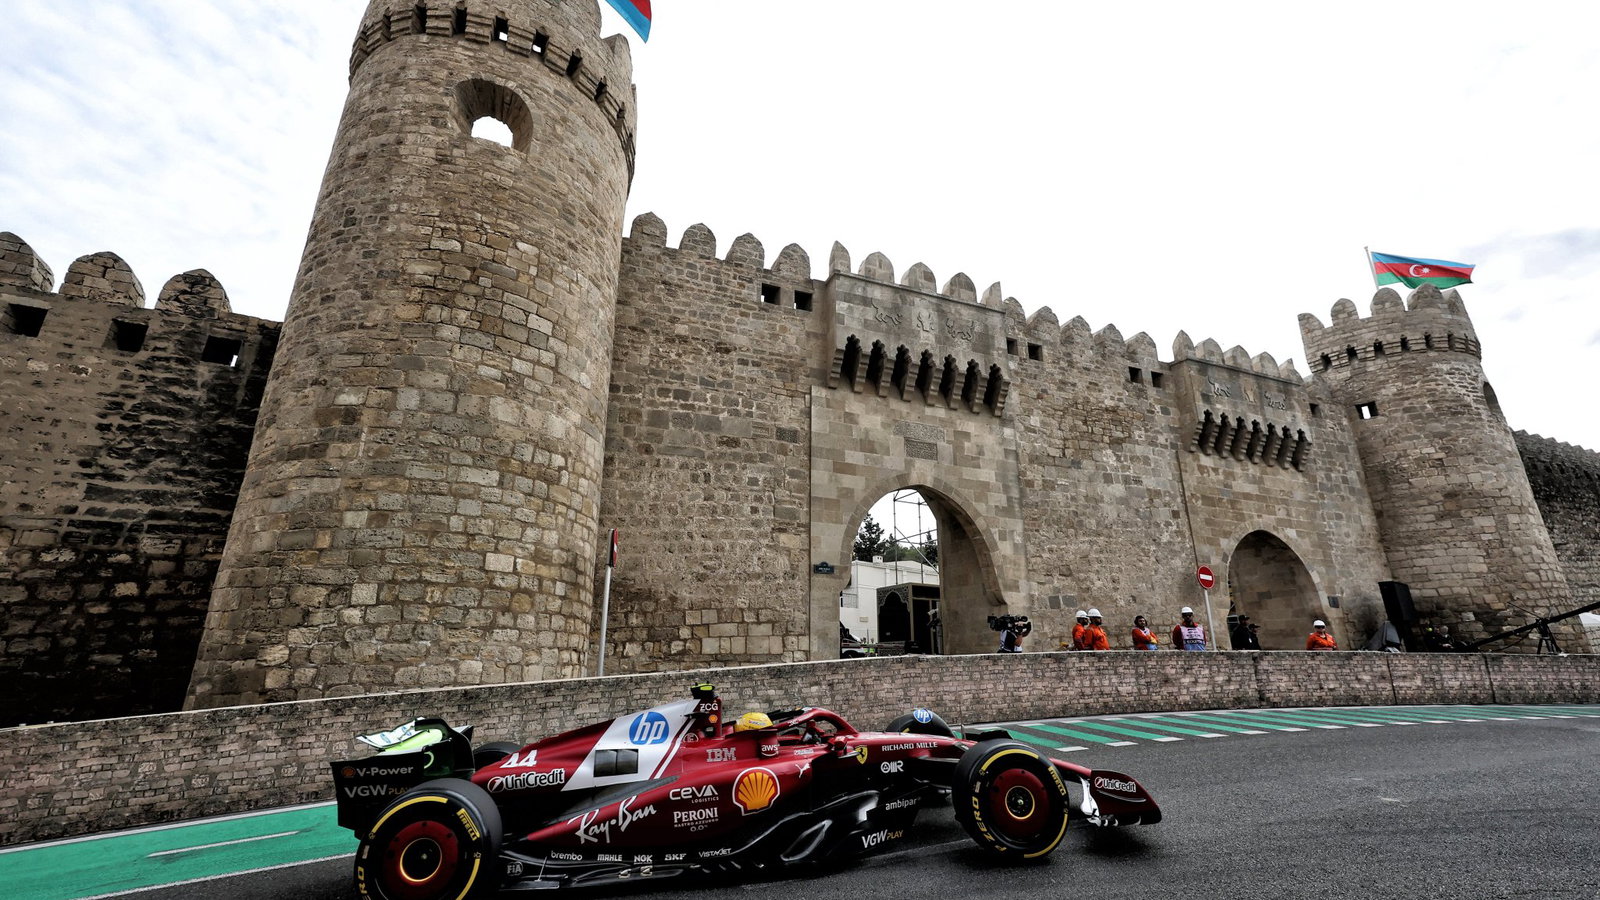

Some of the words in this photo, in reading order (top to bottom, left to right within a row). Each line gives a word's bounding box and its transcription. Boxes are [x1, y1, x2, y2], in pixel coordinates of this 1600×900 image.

[916, 709, 931, 723] hp
[631, 712, 667, 745] hp
[761, 744, 779, 752] aws
[881, 743, 915, 752] RICHARD
[916, 741, 938, 749] MILLE
[499, 749, 538, 769] 44
[706, 747, 737, 762] IBM
[357, 766, 414, 777] V-Power
[504, 768, 565, 790] UniCredit
[1102, 777, 1137, 793] UniCredit
[691, 796, 719, 804] LOGISTICS
[885, 799, 917, 811] ambipar
[673, 807, 719, 824] PERONI
[456, 807, 480, 841] PIRELLI
[551, 850, 583, 861] brembo
[597, 854, 623, 862] MAHLE
[664, 853, 687, 861] SKF
